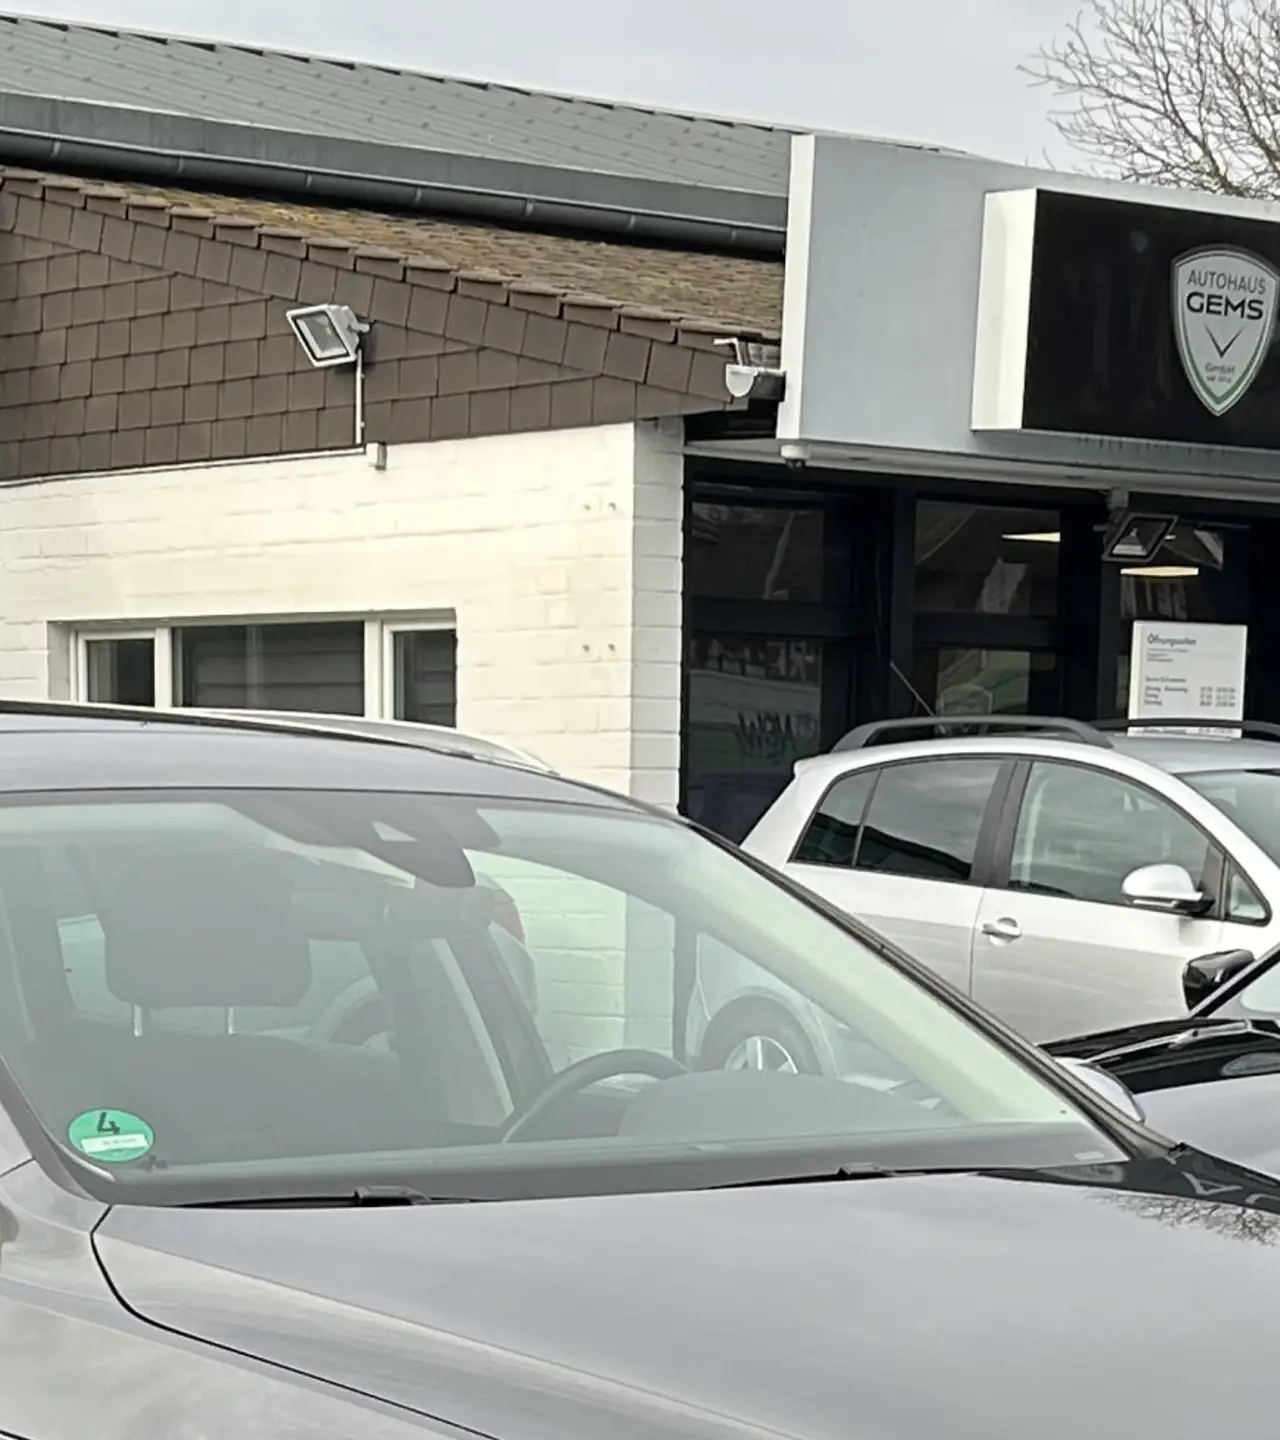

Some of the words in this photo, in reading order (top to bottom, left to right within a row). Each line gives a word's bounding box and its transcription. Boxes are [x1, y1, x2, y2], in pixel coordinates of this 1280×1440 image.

[1187, 270, 1266, 294] AUTOHAUS
[1186, 291, 1264, 320] GEMS
[97, 1111, 120, 1135] 4
